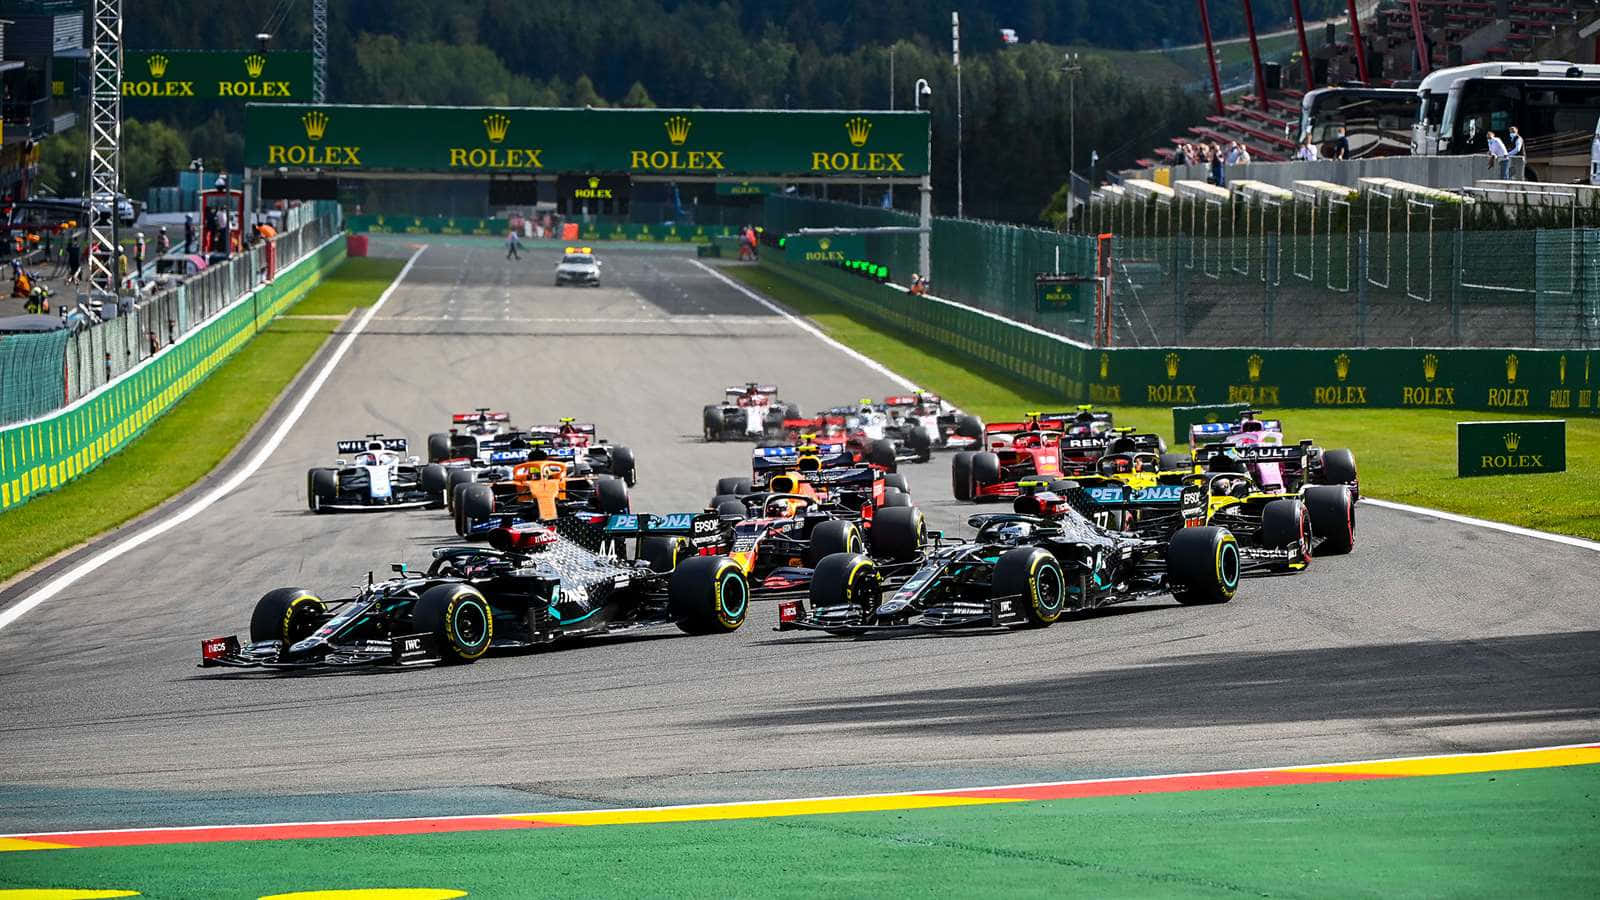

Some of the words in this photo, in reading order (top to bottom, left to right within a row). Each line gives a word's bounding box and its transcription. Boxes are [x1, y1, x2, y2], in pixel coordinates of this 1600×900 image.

[121, 81, 194, 97] ROLEX
[218, 81, 291, 97] ROLEX
[268, 145, 361, 166] ROLEX
[449, 148, 543, 168] ROLEX
[630, 150, 724, 170] ROLEX
[811, 151, 904, 172] ROLEX
[574, 188, 613, 199] ROLEX
[805, 250, 845, 261] ROLEX
[1147, 384, 1198, 403] ROLEX
[1228, 384, 1281, 404] ROLEX
[1314, 386, 1367, 404] ROLEX
[1403, 386, 1456, 405] ROLEX
[1487, 388, 1530, 408] ROLEX
[339, 441, 405, 450] WILLMS
[1070, 436, 1146, 448] RENT
[1208, 447, 1294, 459] RNAULT
[1481, 455, 1543, 469] ROLEX
[1091, 486, 1182, 500] PETONAS
[695, 519, 719, 532] EPSON
[1094, 511, 1108, 529] 77
[599, 539, 617, 561] 44
[405, 639, 421, 650] IWC
